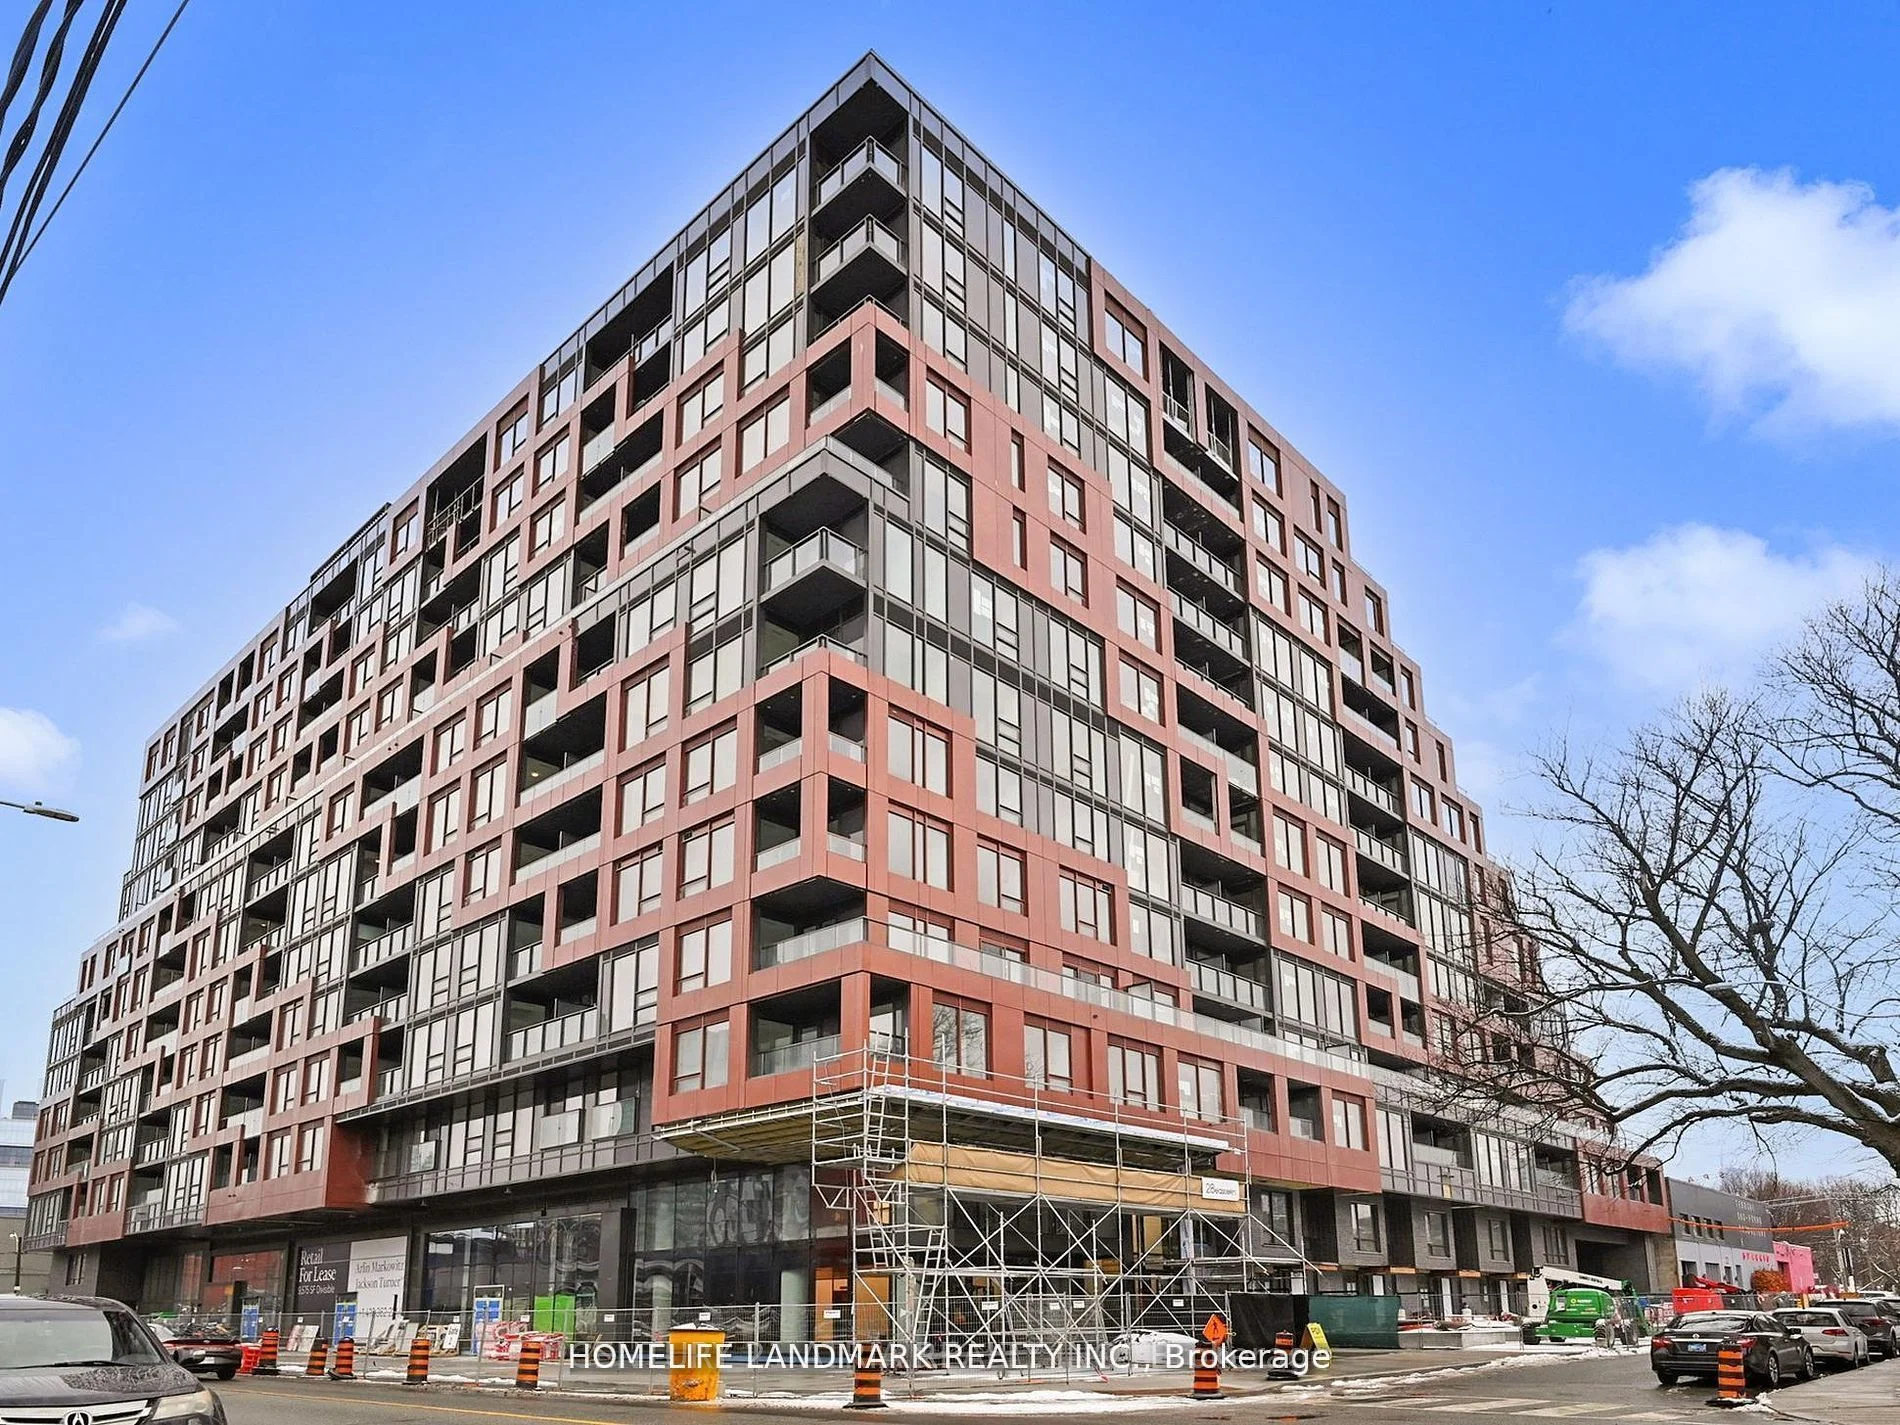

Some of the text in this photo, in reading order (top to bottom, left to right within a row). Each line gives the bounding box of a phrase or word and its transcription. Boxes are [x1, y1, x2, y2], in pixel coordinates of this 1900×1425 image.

[300, 1248, 323, 1266] Retail
[299, 1266, 337, 1282] For Lease
